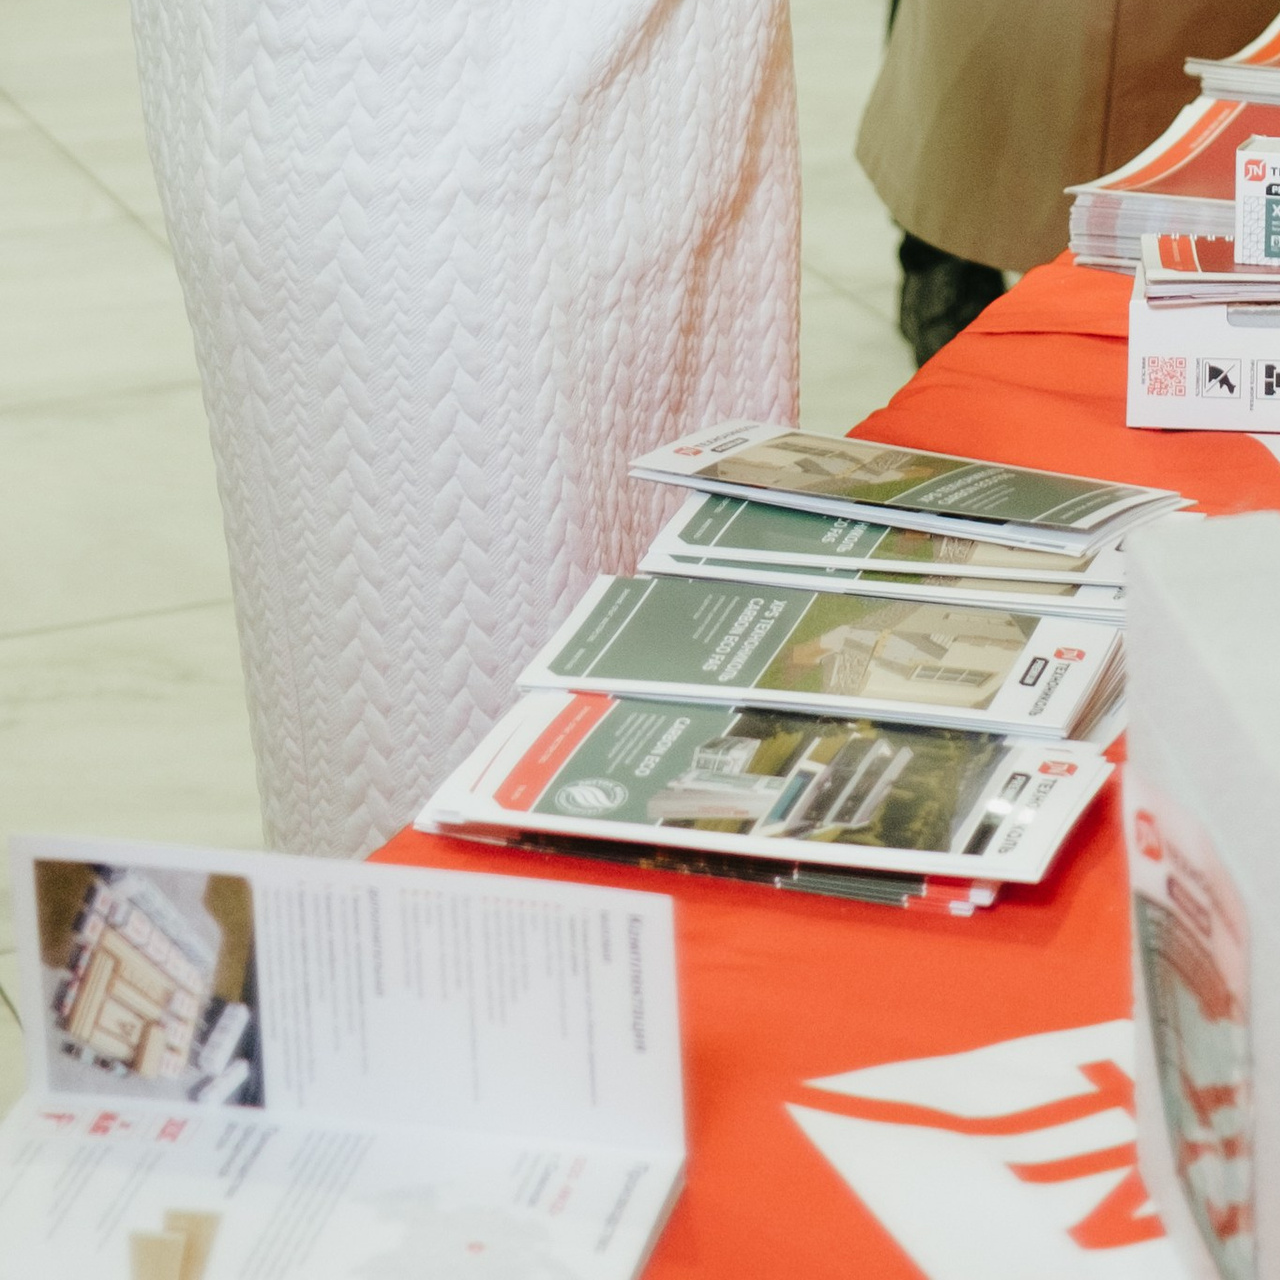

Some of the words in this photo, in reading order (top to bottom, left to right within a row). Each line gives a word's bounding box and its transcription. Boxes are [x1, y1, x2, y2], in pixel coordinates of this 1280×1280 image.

[728, 598, 765, 635] CARBON
[764, 599, 788, 618] XPS
[715, 635, 740, 654] ECO
[718, 619, 775, 682] ТЕХНОНИКОЛЬ
[702, 653, 726, 671] FAS
[650, 717, 691, 756] CARBON
[634, 755, 660, 777] ECO
